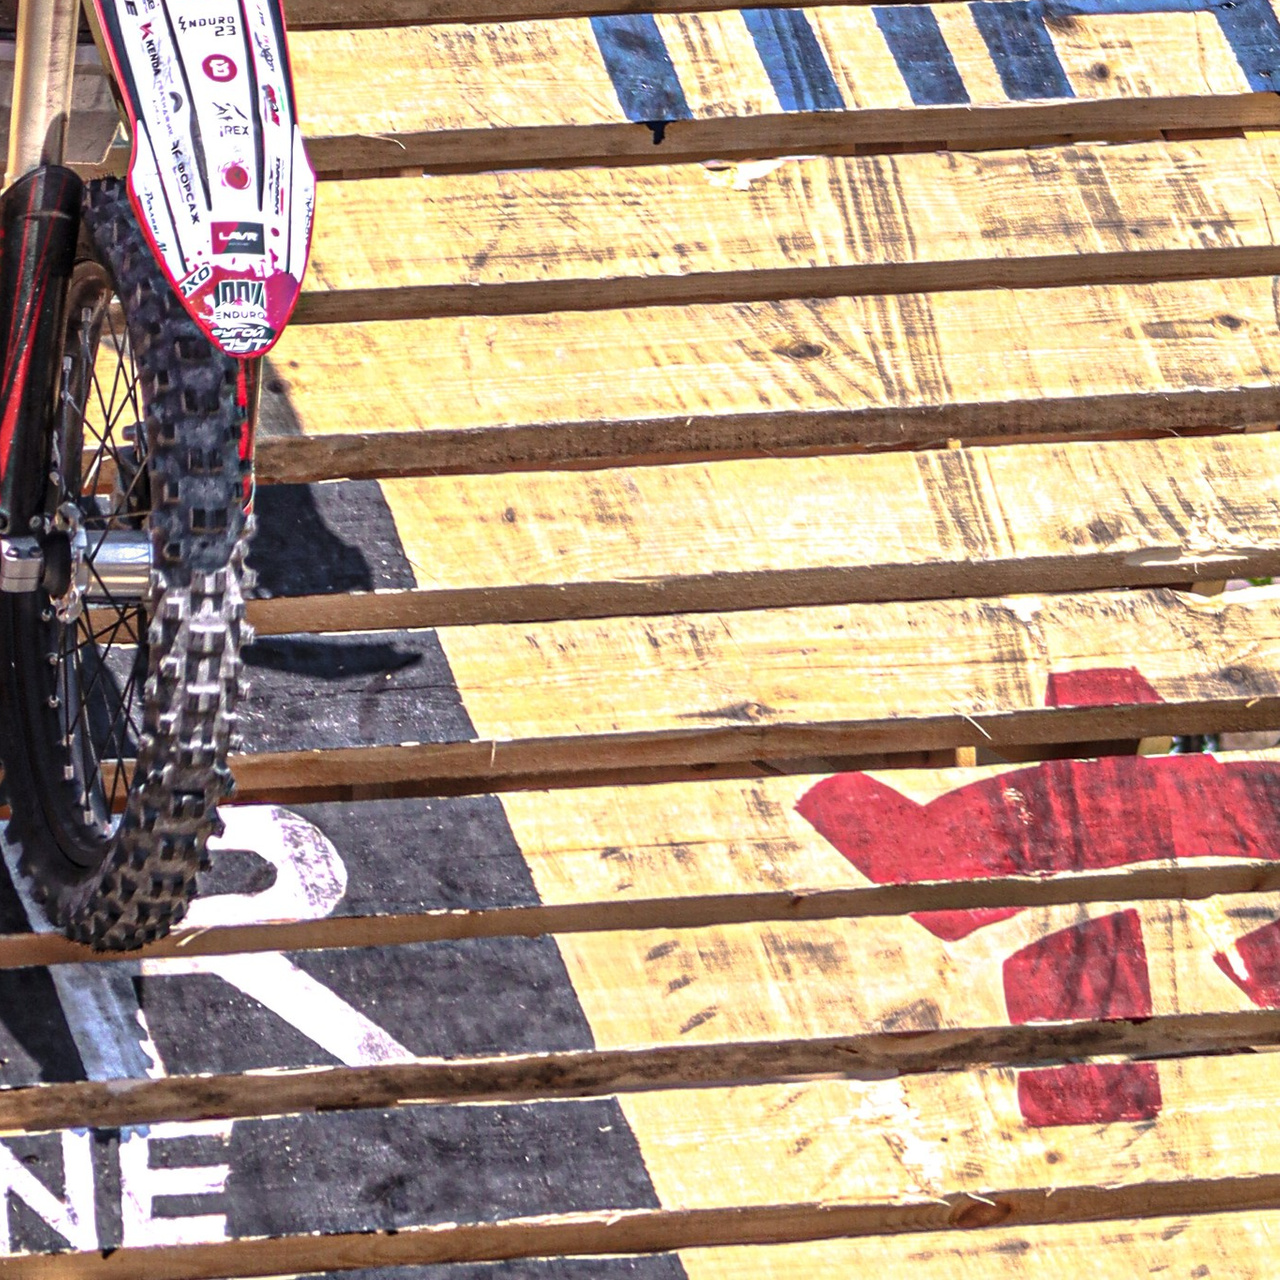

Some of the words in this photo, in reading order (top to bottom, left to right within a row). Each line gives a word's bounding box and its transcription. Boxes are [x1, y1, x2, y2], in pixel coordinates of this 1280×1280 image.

[214, 25, 237, 37] 23
[145, 39, 162, 76] KENDA
[177, 162, 201, 225] ФОРСАЖ
[219, 230, 259, 243] LAVR
[215, 310, 266, 320] ENDURO
